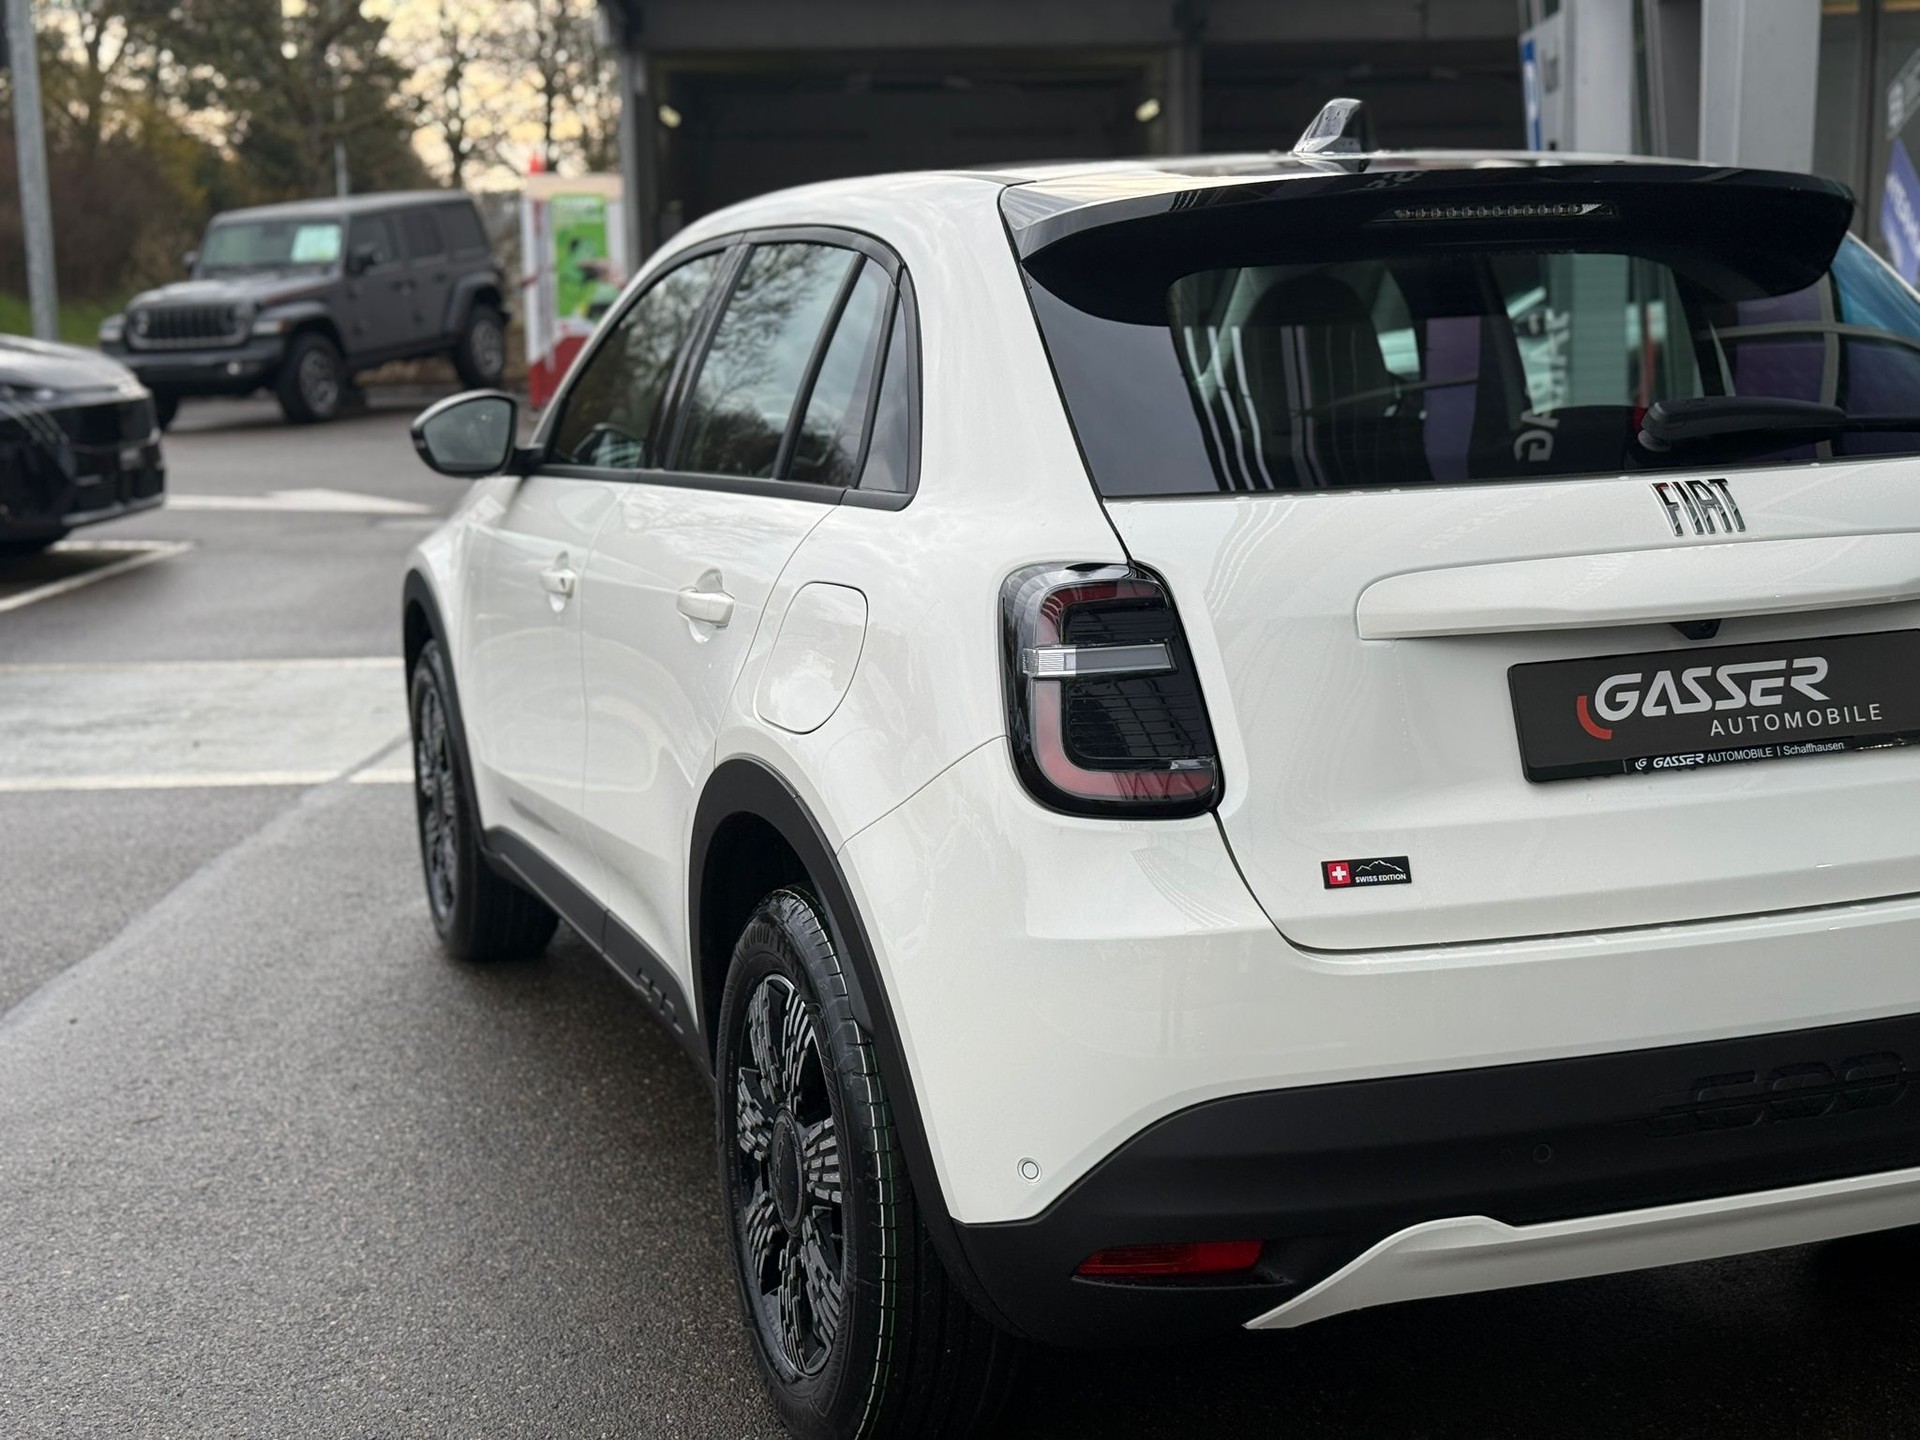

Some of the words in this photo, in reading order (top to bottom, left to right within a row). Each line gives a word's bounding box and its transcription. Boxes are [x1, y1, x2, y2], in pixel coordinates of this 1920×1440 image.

[1649, 478, 1746, 537] FIAT
[1594, 656, 1831, 722] GASSER
[1710, 703, 1883, 737] AUTOMOBILE
[1653, 753, 1704, 769] GASSER
[1707, 747, 1774, 763] AUTOMOBILE
[1783, 741, 1845, 756] Schaffhausen
[1355, 875, 1378, 883] SWISS
[1378, 873, 1407, 882] EDITION
